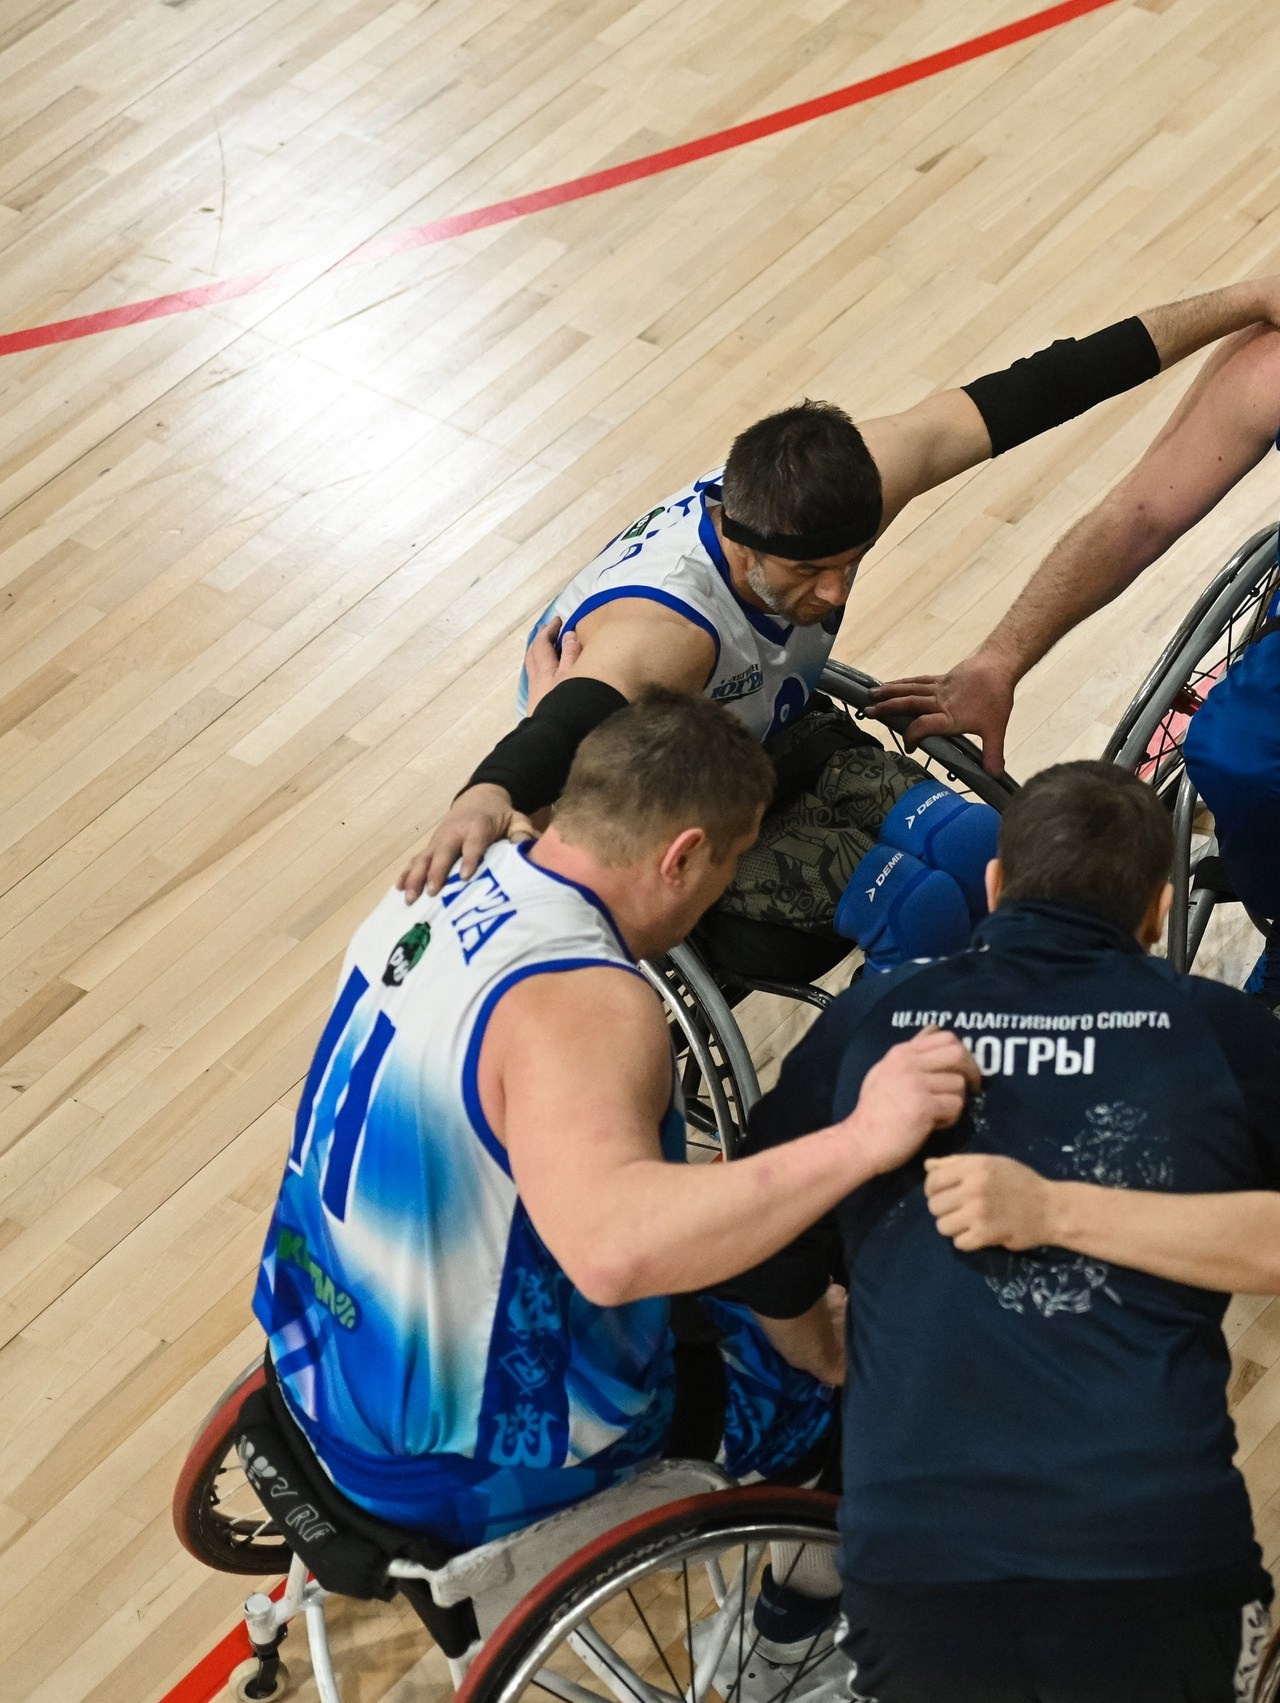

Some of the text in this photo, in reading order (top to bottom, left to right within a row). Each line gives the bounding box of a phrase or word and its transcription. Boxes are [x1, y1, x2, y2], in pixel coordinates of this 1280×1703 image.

[916, 790, 951, 815] DEMIX
[876, 851, 904, 887] DEMIX
[953, 1011, 1094, 1031] АДАПТИВНОГО
[1096, 1010, 1171, 1029] СПОРТА
